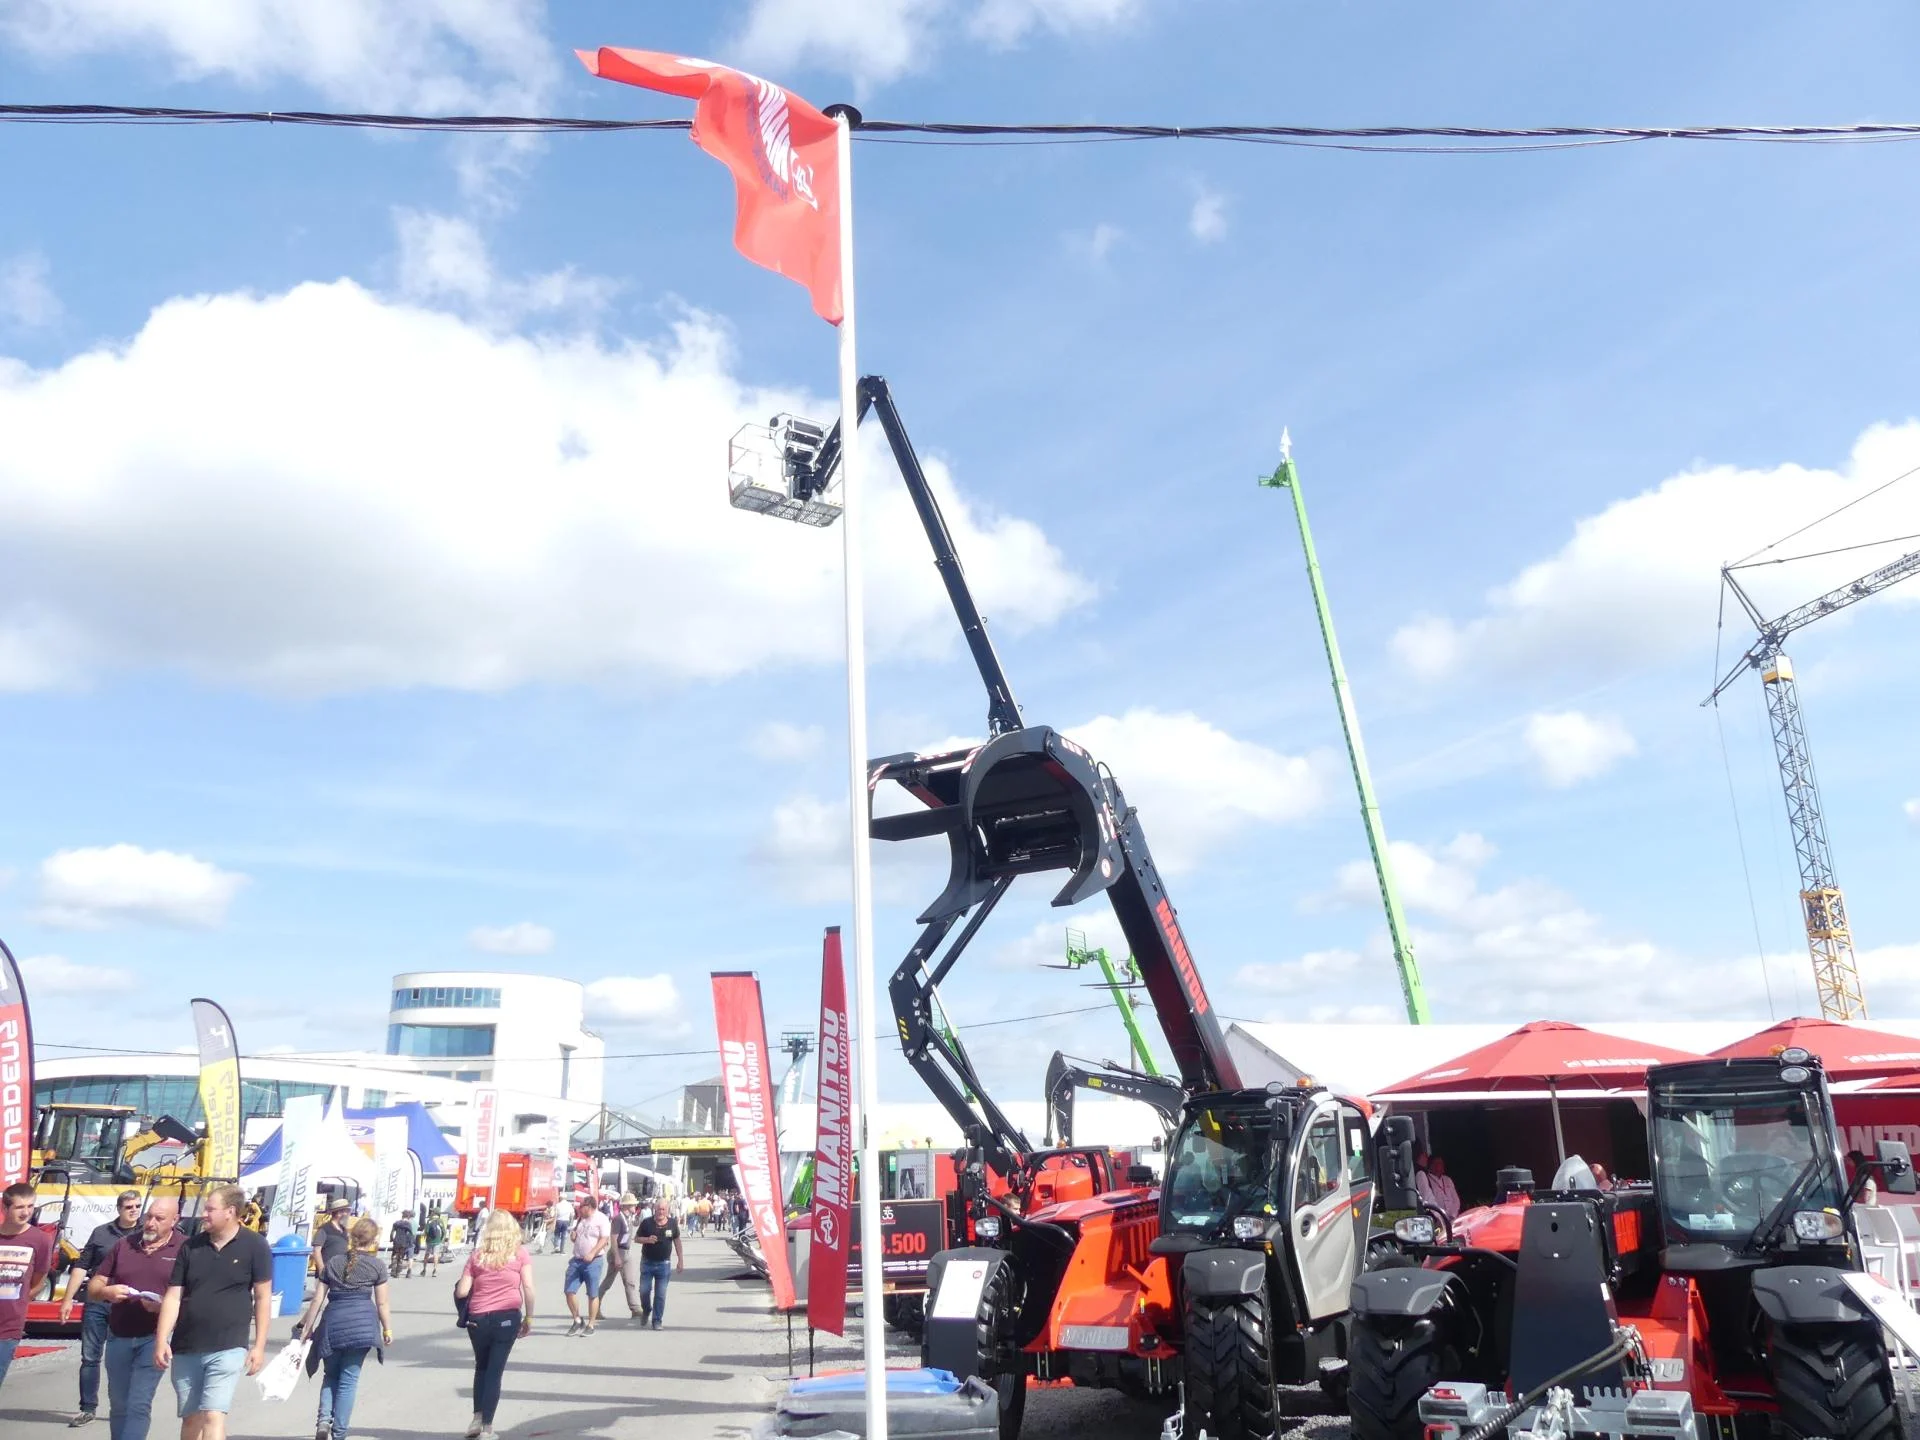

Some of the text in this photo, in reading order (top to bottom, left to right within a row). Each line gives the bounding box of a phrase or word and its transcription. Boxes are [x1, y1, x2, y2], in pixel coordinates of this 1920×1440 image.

[1156, 897, 1208, 1015] MANITOU
[744, 1041, 761, 1091] WORLD
[816, 1007, 840, 1205] MANITOU
[1102, 1081, 1141, 1094] VOLVO
[722, 1040, 770, 1201] MANITOU
[750, 1092, 766, 1130] YOUR
[839, 1012, 849, 1210] HANDLING YOUR WORLD
[881, 1209, 894, 1220] 35
